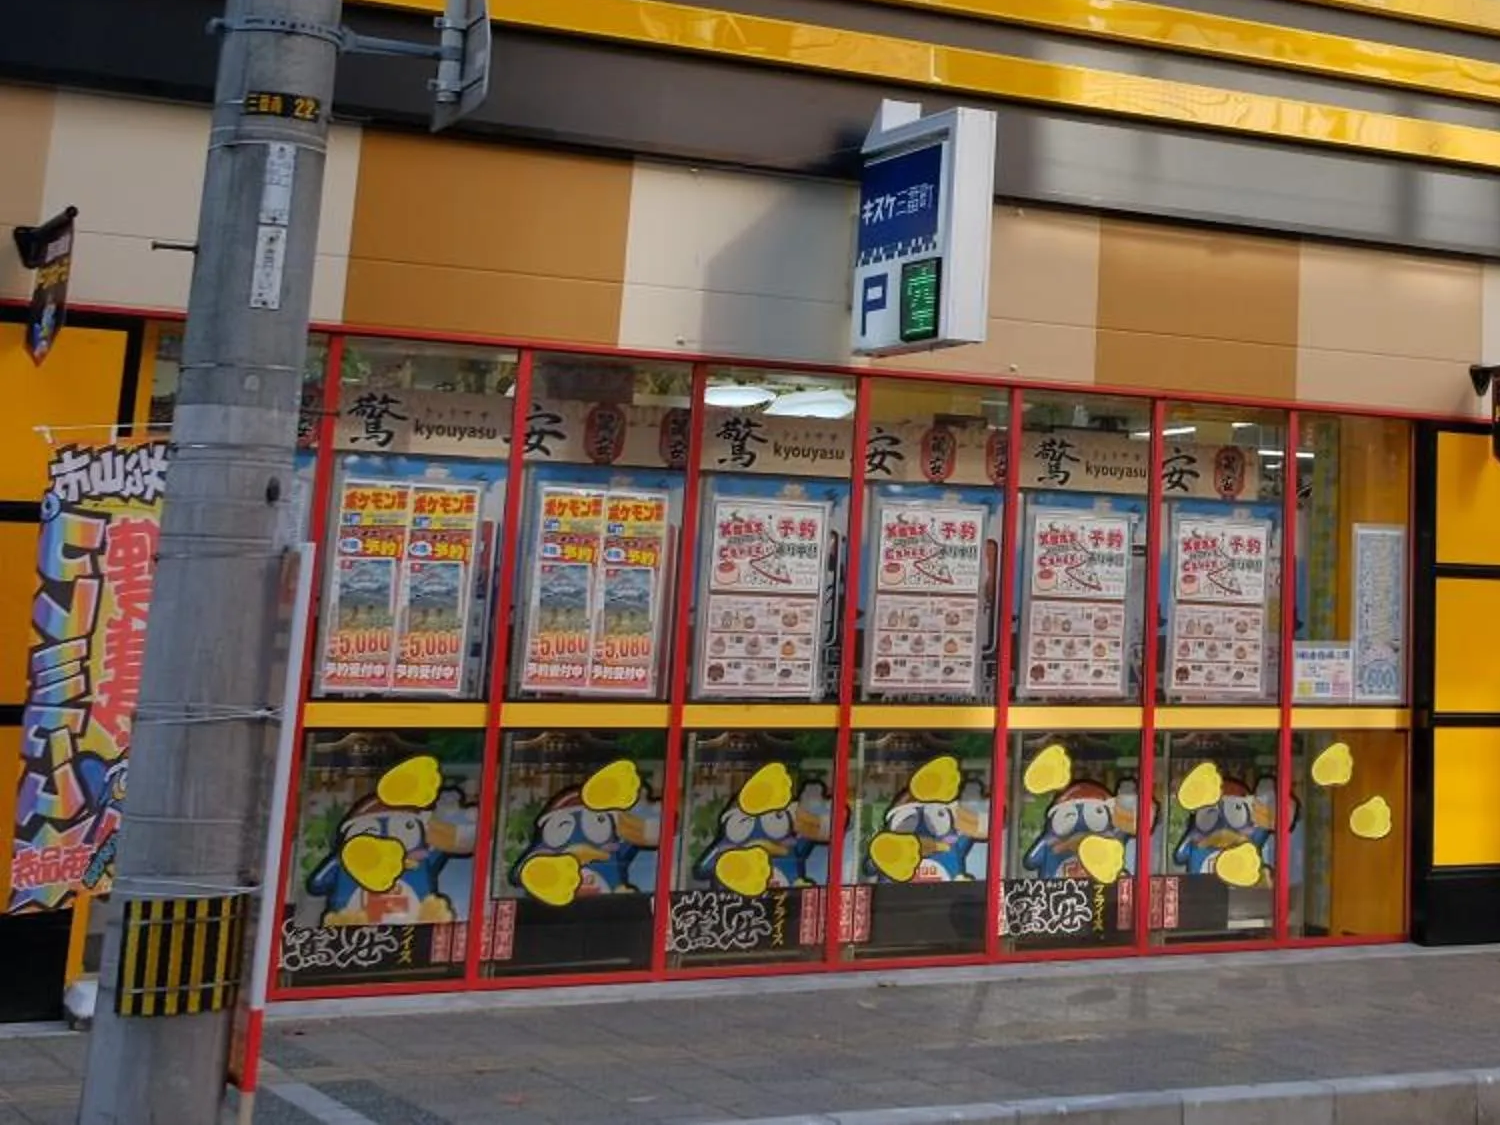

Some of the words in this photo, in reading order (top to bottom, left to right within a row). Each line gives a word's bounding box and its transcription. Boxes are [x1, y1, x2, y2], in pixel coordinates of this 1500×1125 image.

[413, 418, 498, 442] kyouyasu
[773, 441, 845, 462] kyouyasu
[1085, 460, 1148, 479] kyouyasu
